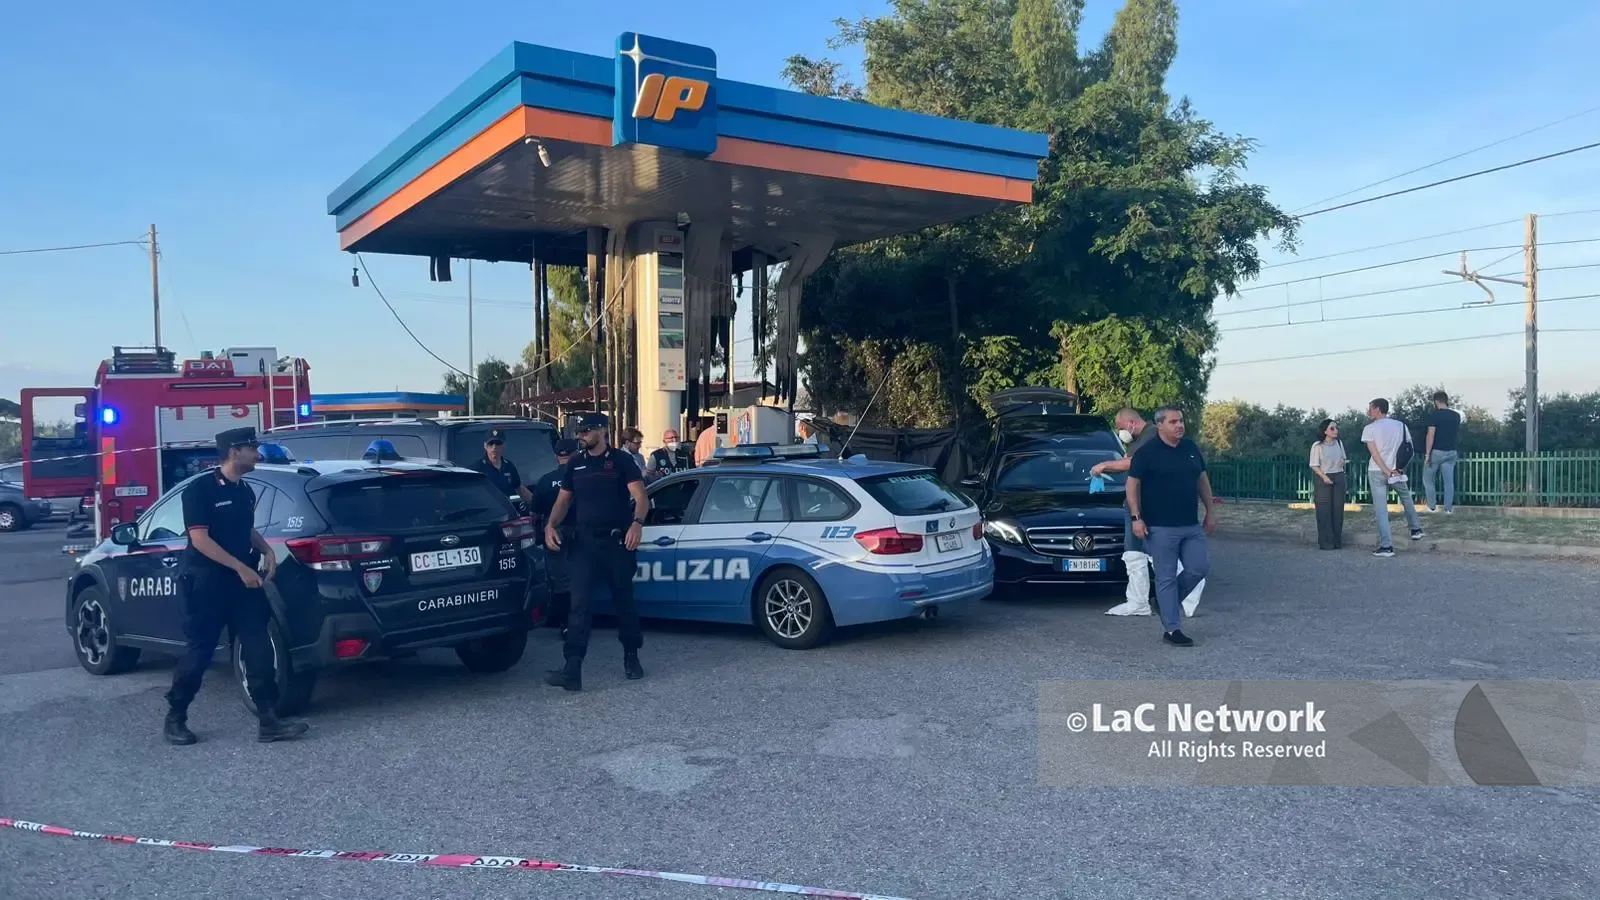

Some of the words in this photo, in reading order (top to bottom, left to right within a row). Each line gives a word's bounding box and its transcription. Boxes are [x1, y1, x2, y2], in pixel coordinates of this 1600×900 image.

[632, 73, 710, 122] IP
[190, 361, 226, 369] BAI
[287, 516, 304, 528] 1515
[820, 525, 857, 539] 113
[498, 556, 517, 571] 1515
[418, 589, 499, 612] CARABINIERI
